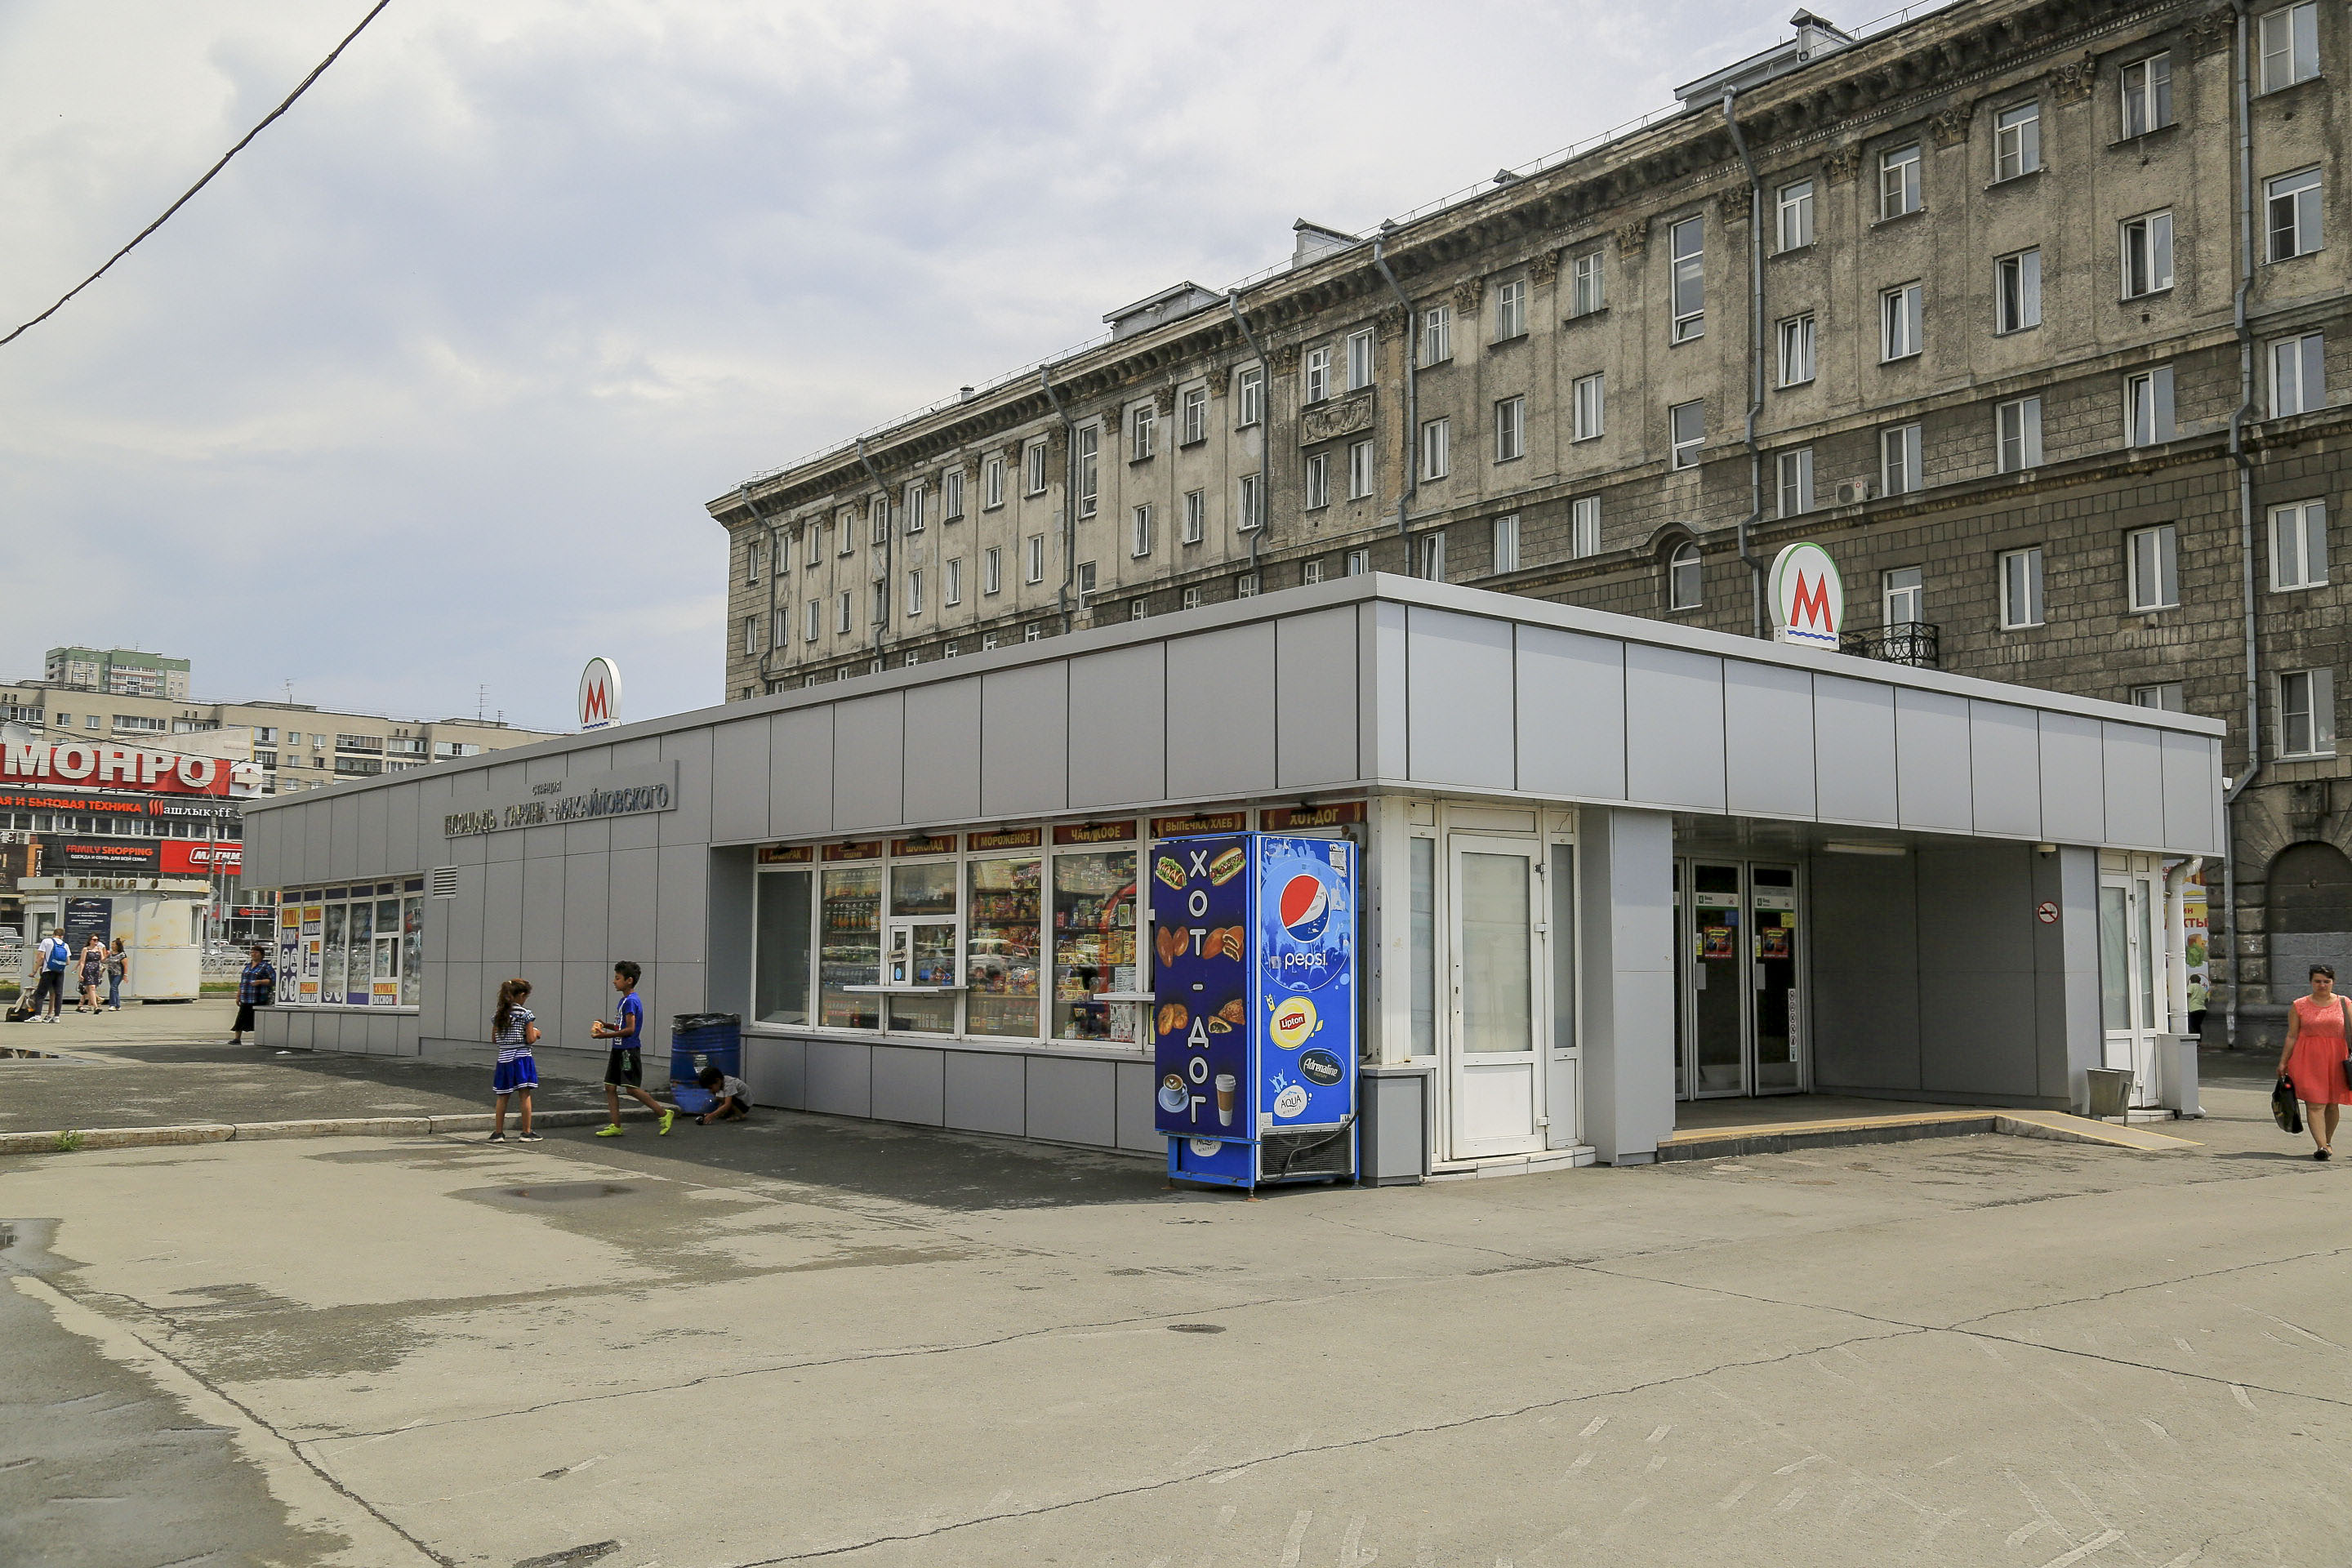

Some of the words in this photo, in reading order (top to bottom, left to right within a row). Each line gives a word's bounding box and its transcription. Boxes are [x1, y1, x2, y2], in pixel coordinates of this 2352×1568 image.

[1790, 568, 1833, 632] М
[584, 676, 608, 723] М
[4, 738, 216, 787] МОНРО
[532, 781, 561, 795] СТАНЦИЯ
[28, 797, 86, 809] БЫТОВАЯ
[88, 800, 142, 813] ТЕХНИКА
[444, 808, 497, 835] ПЛОЩАДЬ
[981, 832, 1031, 847] МОРОЖЕНОЕ
[66, 844, 100, 854] FAMILY
[101, 846, 154, 856] SHOPPING
[1285, 949, 1327, 969] pepsi
[1281, 1016, 1303, 1028] Lipton
[1303, 1058, 1339, 1077] Adrenaline
[1281, 1094, 1302, 1109] AQUA
[1282, 1106, 1301, 1114] MINERALE
